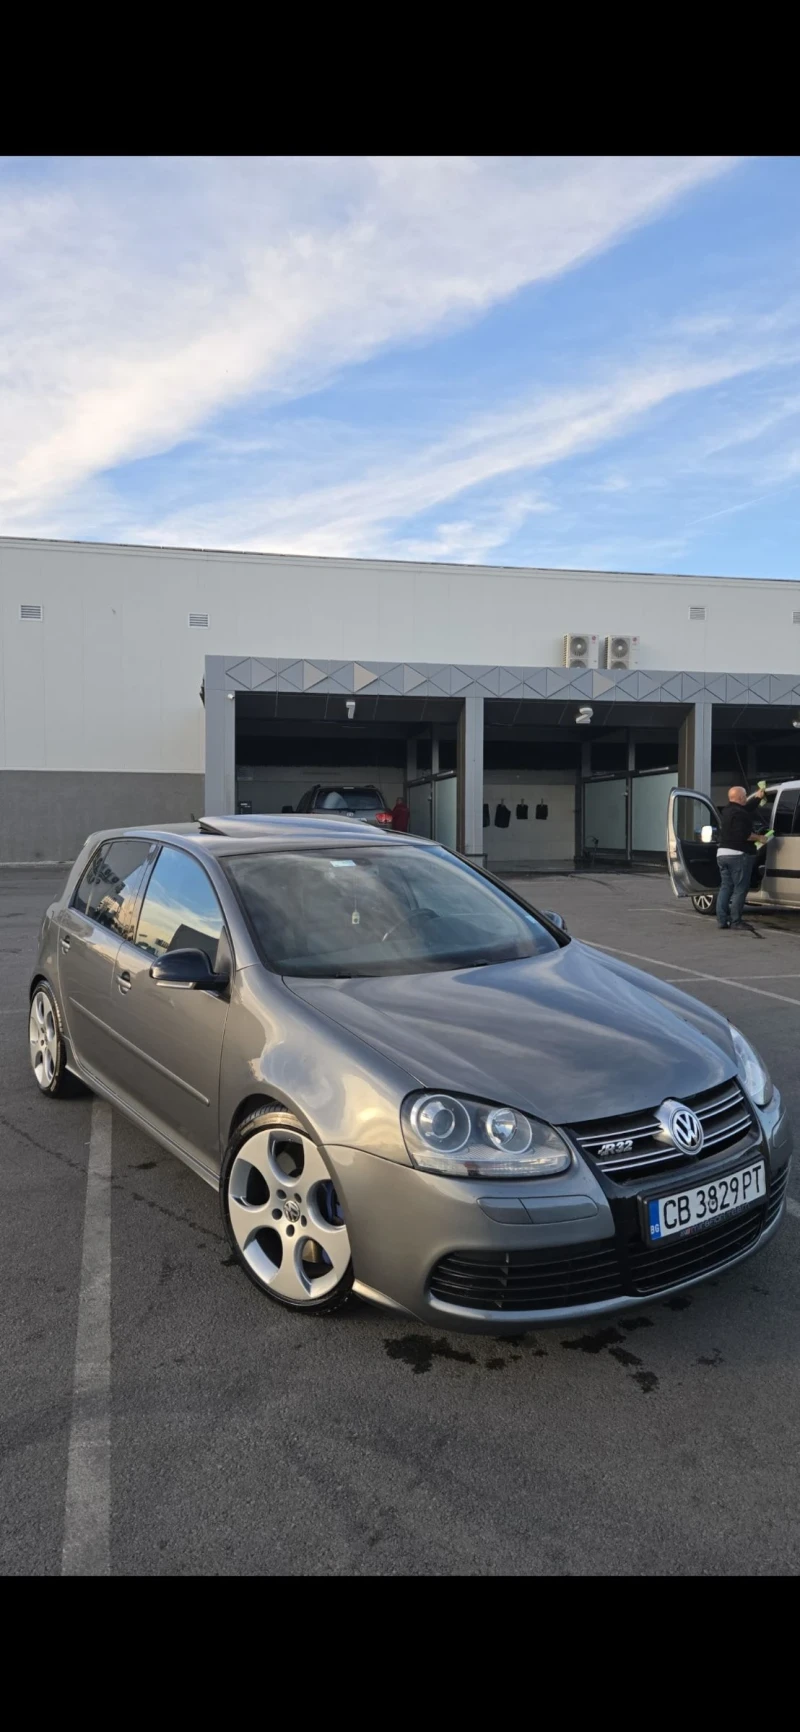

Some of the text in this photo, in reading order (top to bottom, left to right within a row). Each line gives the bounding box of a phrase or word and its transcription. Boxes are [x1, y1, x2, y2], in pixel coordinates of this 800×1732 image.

[346, 701, 356, 719] 1
[576, 707, 593, 724] 2
[663, 1195, 691, 1229] CB
[696, 1177, 739, 1218] 3829
[742, 1165, 761, 1200] PT
[650, 1224, 660, 1234] BG
